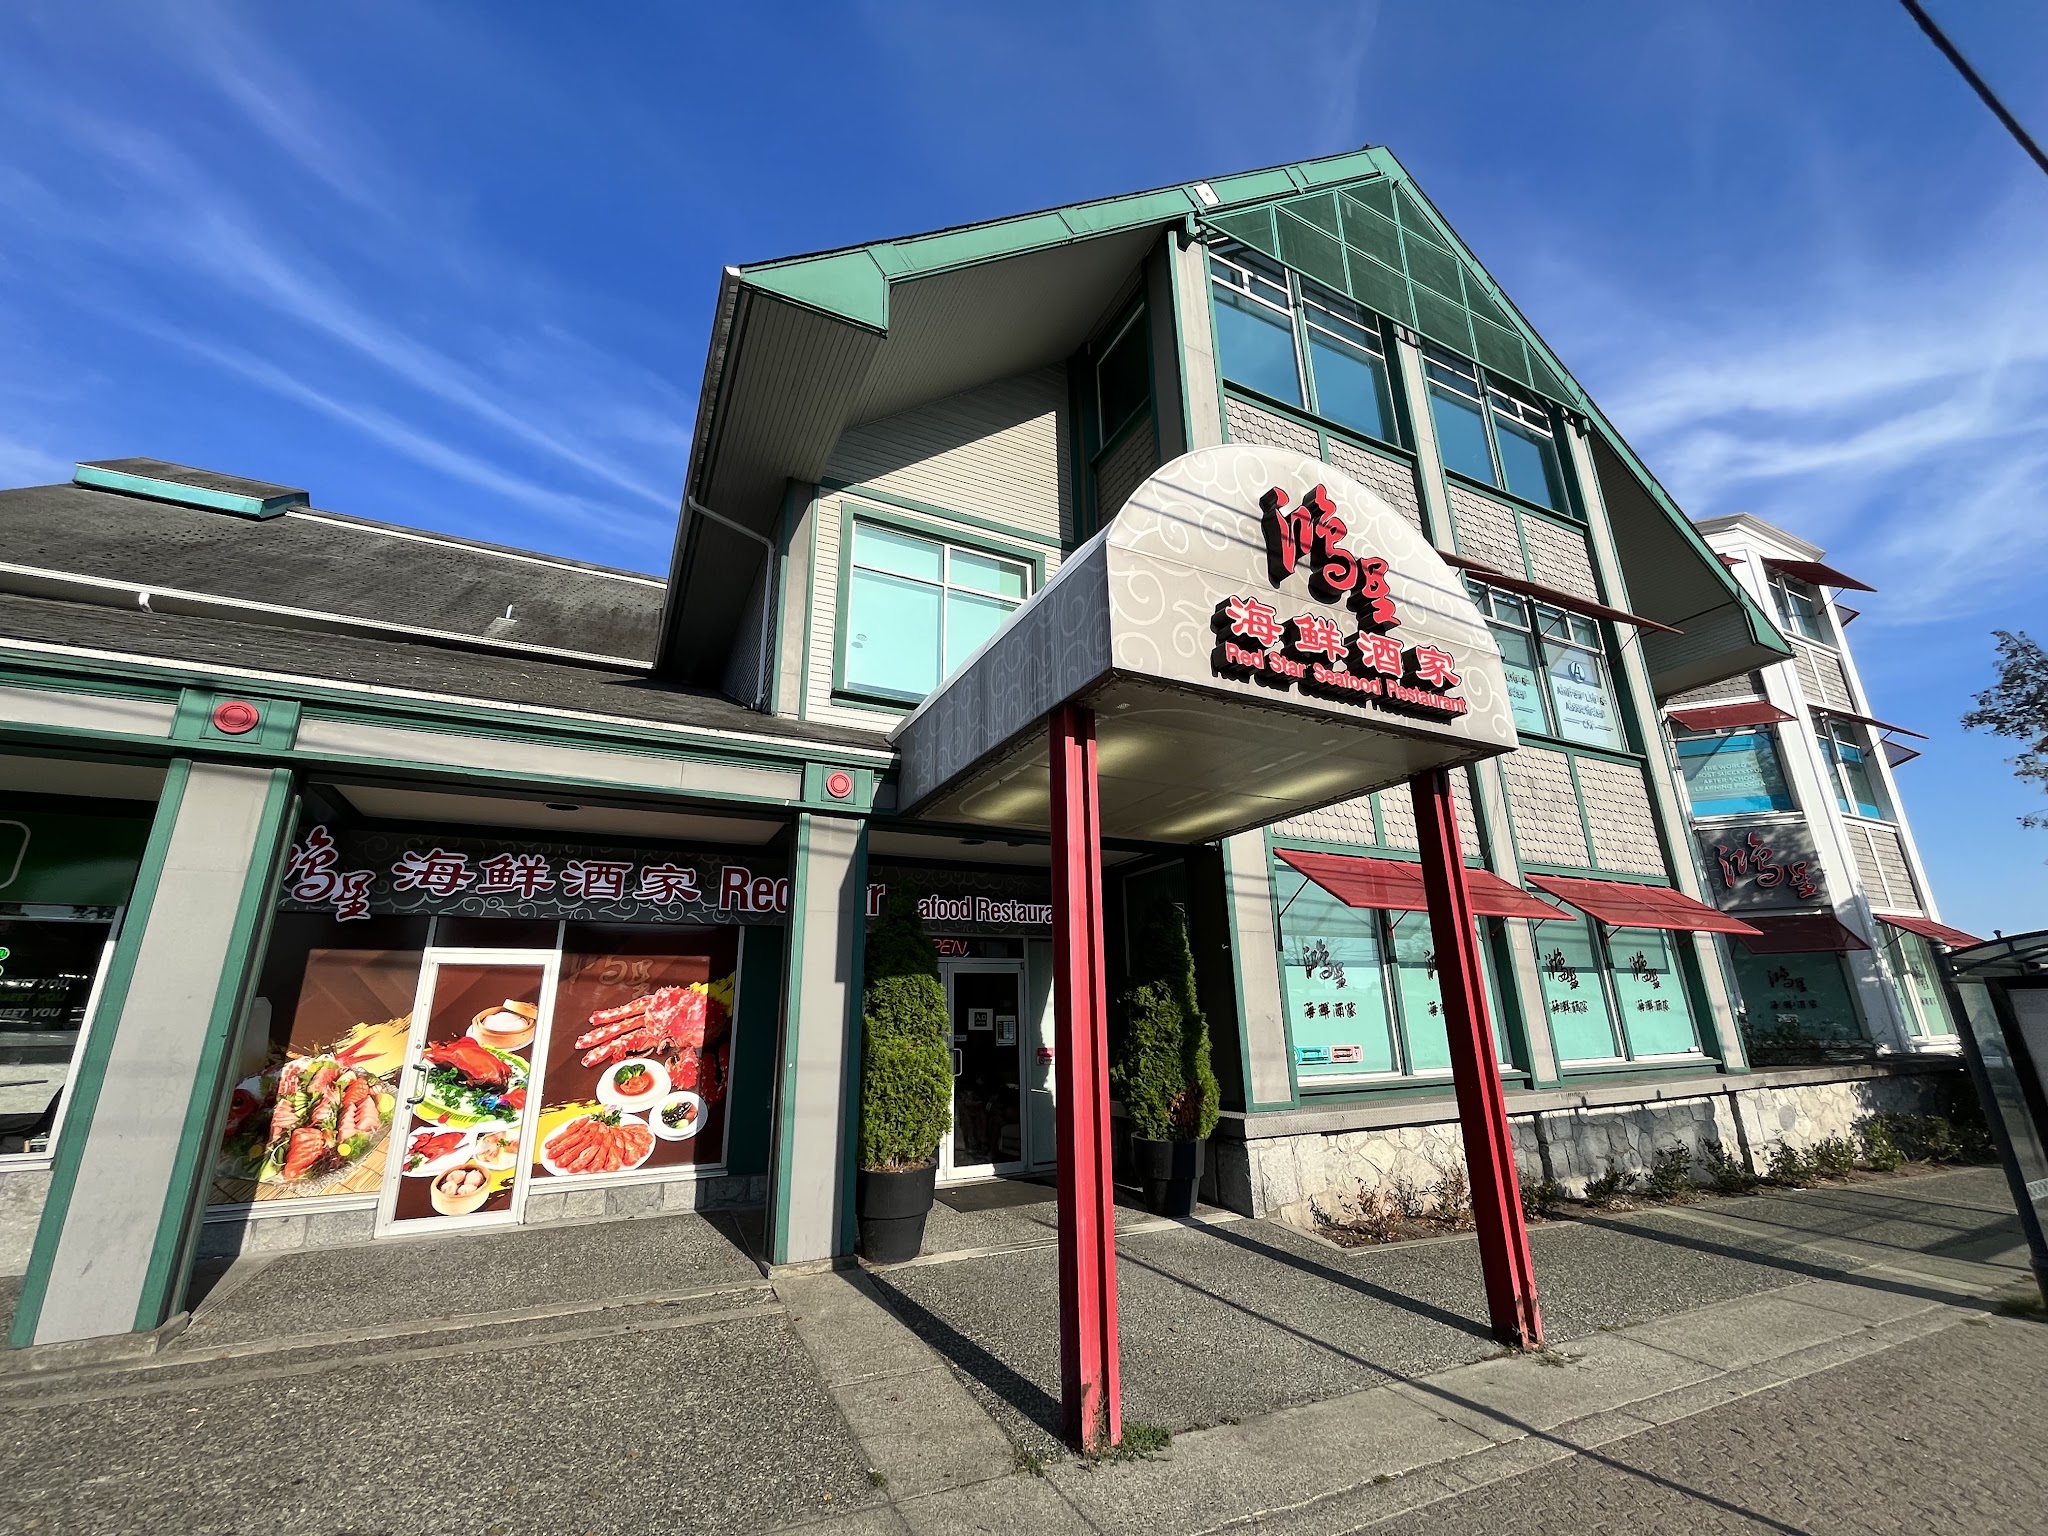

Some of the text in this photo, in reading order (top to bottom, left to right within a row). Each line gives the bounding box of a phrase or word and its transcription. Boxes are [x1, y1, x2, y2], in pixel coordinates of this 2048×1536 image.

[1224, 594, 1463, 688] 海鮮酒家
[1225, 641, 1468, 715] Red Star Seafood Restaurant
[390, 847, 702, 905] 海鮮酒家
[932, 939, 968, 955] PEN
[32, 1008, 62, 1018] YOU
